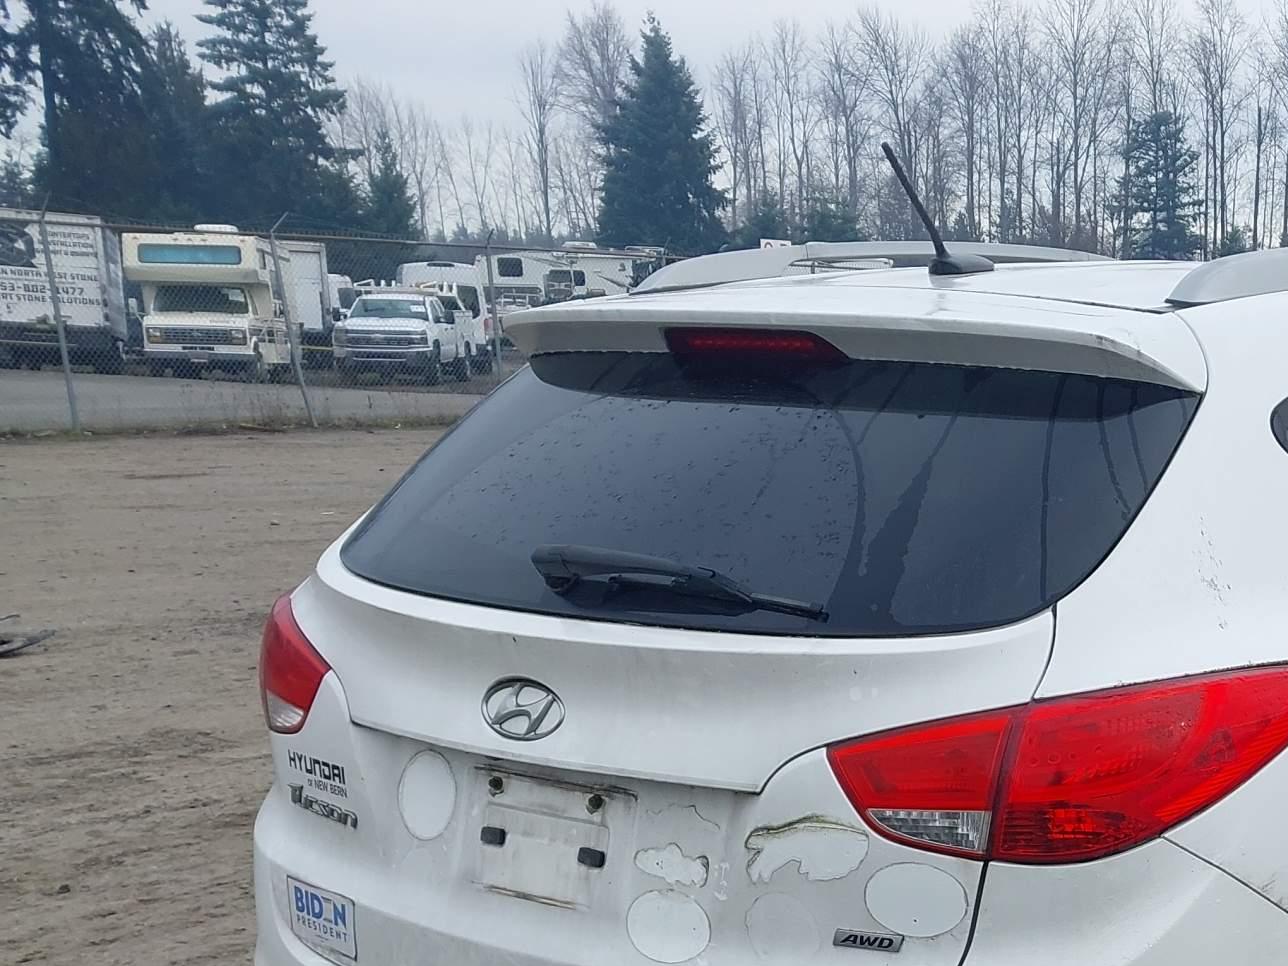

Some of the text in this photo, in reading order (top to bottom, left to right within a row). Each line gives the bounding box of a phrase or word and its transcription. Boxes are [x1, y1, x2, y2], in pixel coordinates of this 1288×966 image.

[287, 749, 346, 785] HYUNDAI
[314, 779, 329, 792] NEW
[329, 783, 348, 799] BERN
[296, 913, 348, 943] PRESIDENT
[840, 934, 894, 949] AWD
